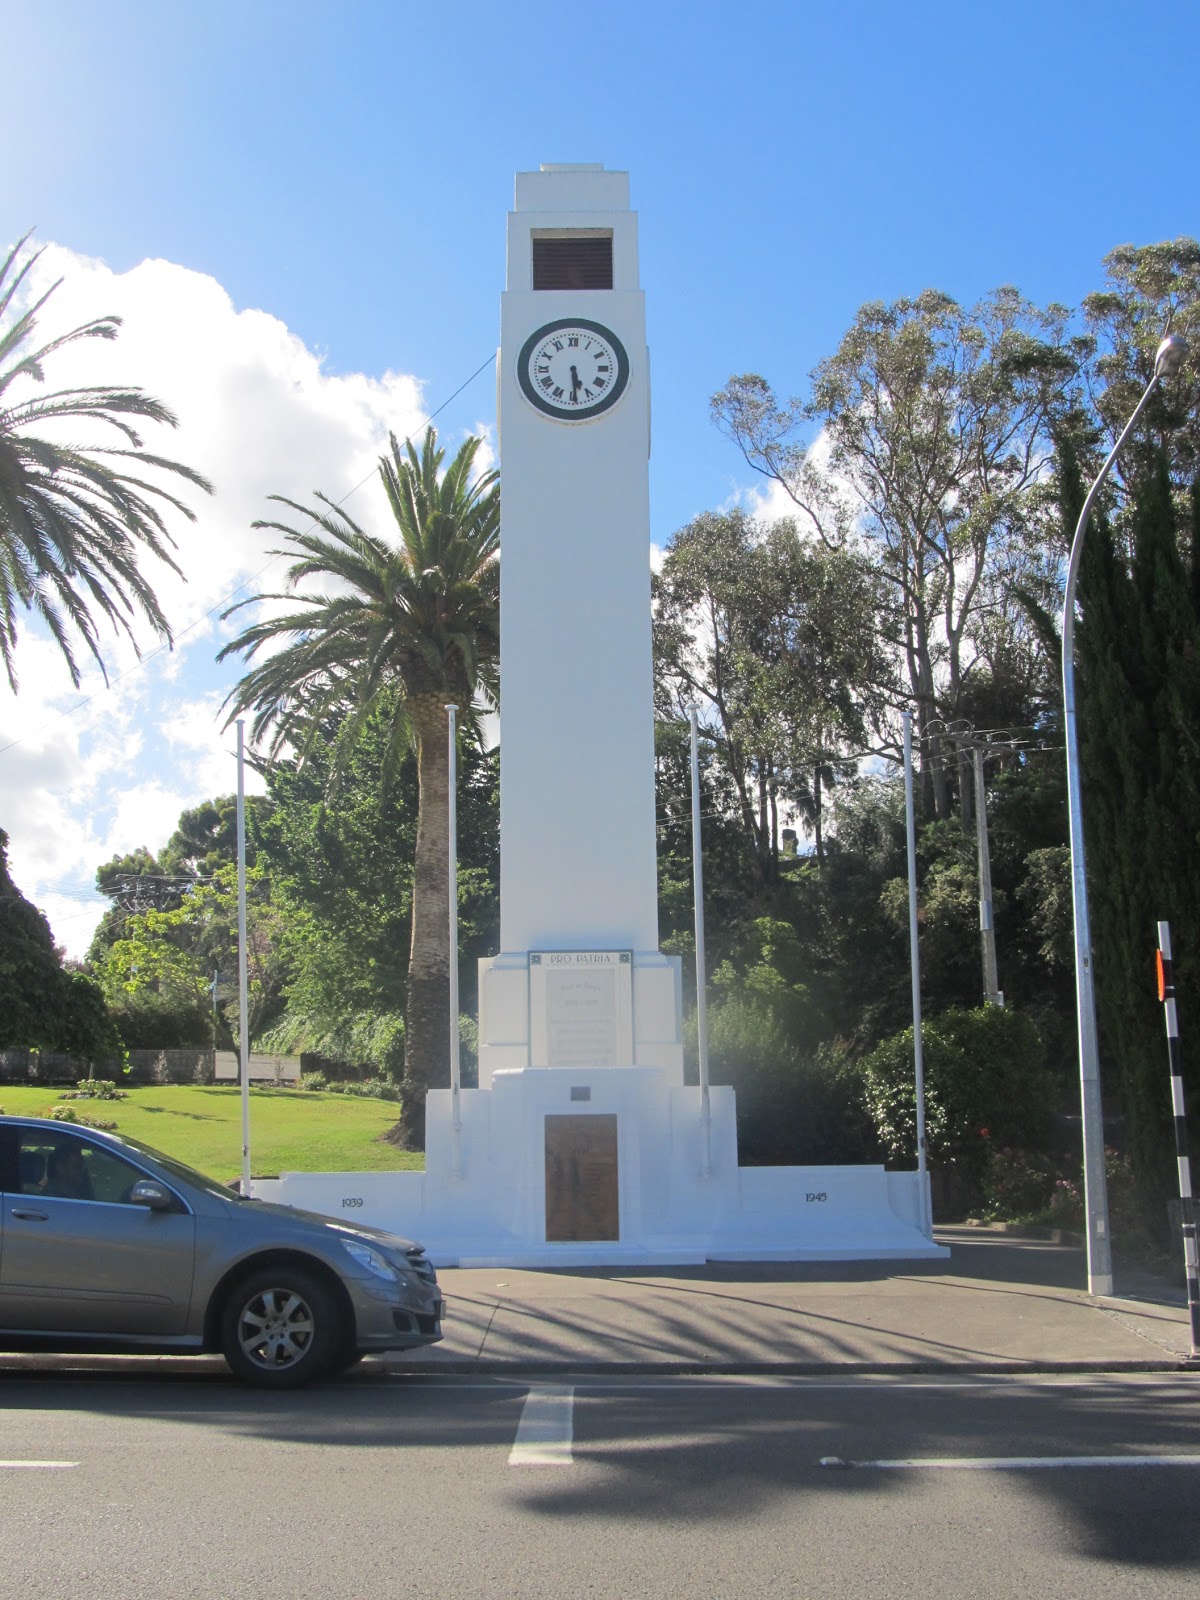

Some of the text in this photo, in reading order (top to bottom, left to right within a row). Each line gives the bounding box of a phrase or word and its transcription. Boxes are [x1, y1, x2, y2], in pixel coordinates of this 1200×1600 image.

[550, 954, 611, 964] PRO PATRIA
[341, 1197, 364, 1208] 1939
[805, 1192, 828, 1203] 1945
